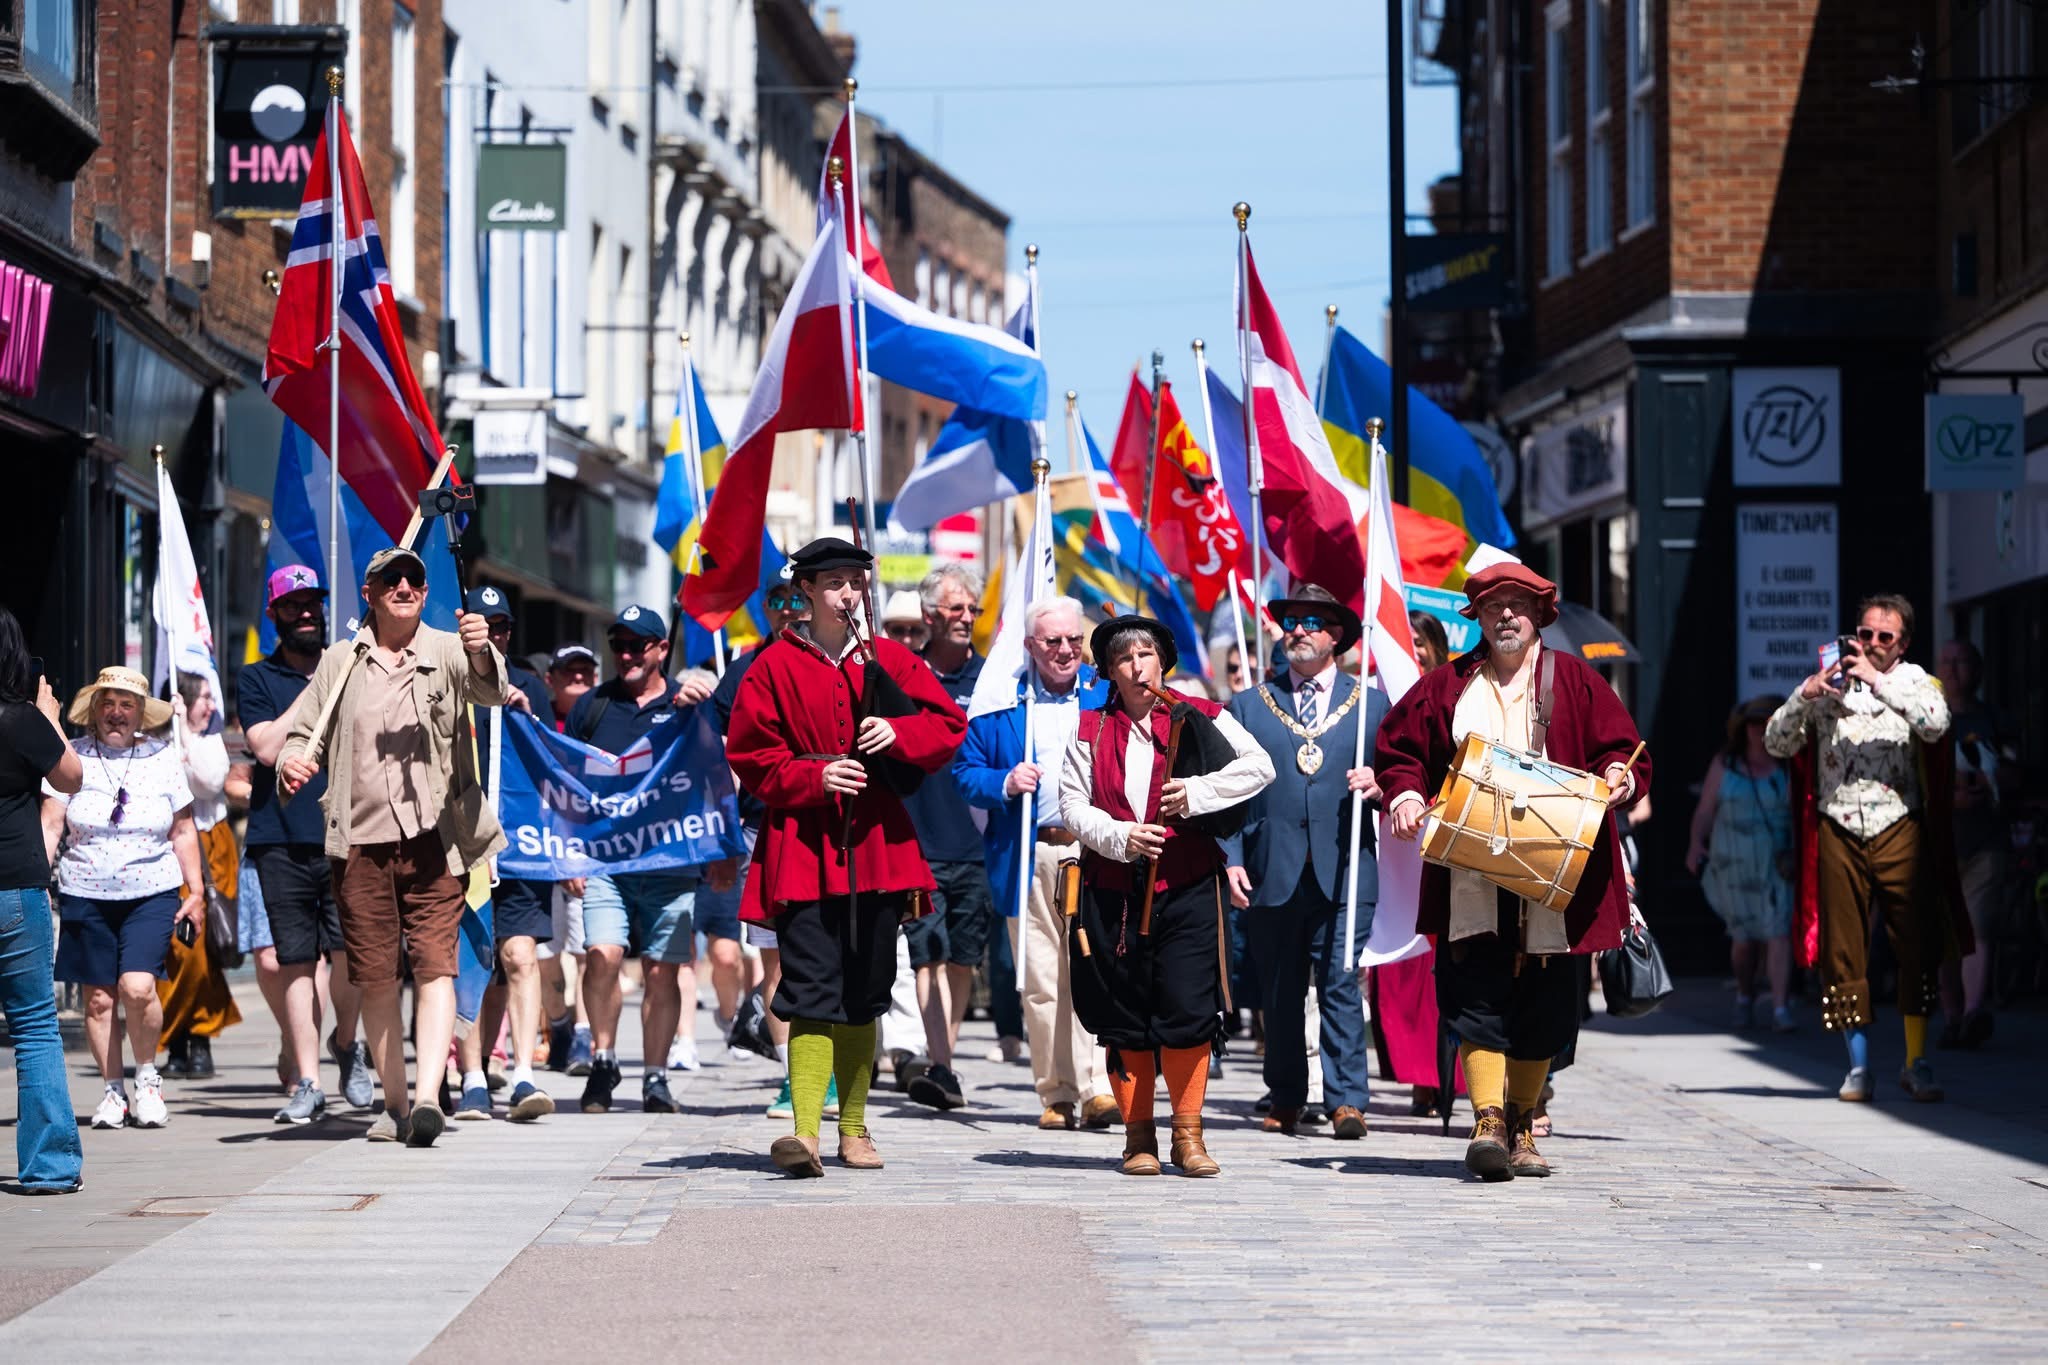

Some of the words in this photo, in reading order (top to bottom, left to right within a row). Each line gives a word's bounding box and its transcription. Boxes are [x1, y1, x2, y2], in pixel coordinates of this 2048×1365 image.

[1405, 245, 1499, 300] SUBWAY
[1943, 420, 2015, 458] VPZ
[1741, 511, 1833, 534] TIME2VAPE
[541, 770, 692, 818] Nelson's
[516, 810, 726, 860] Shantymen
